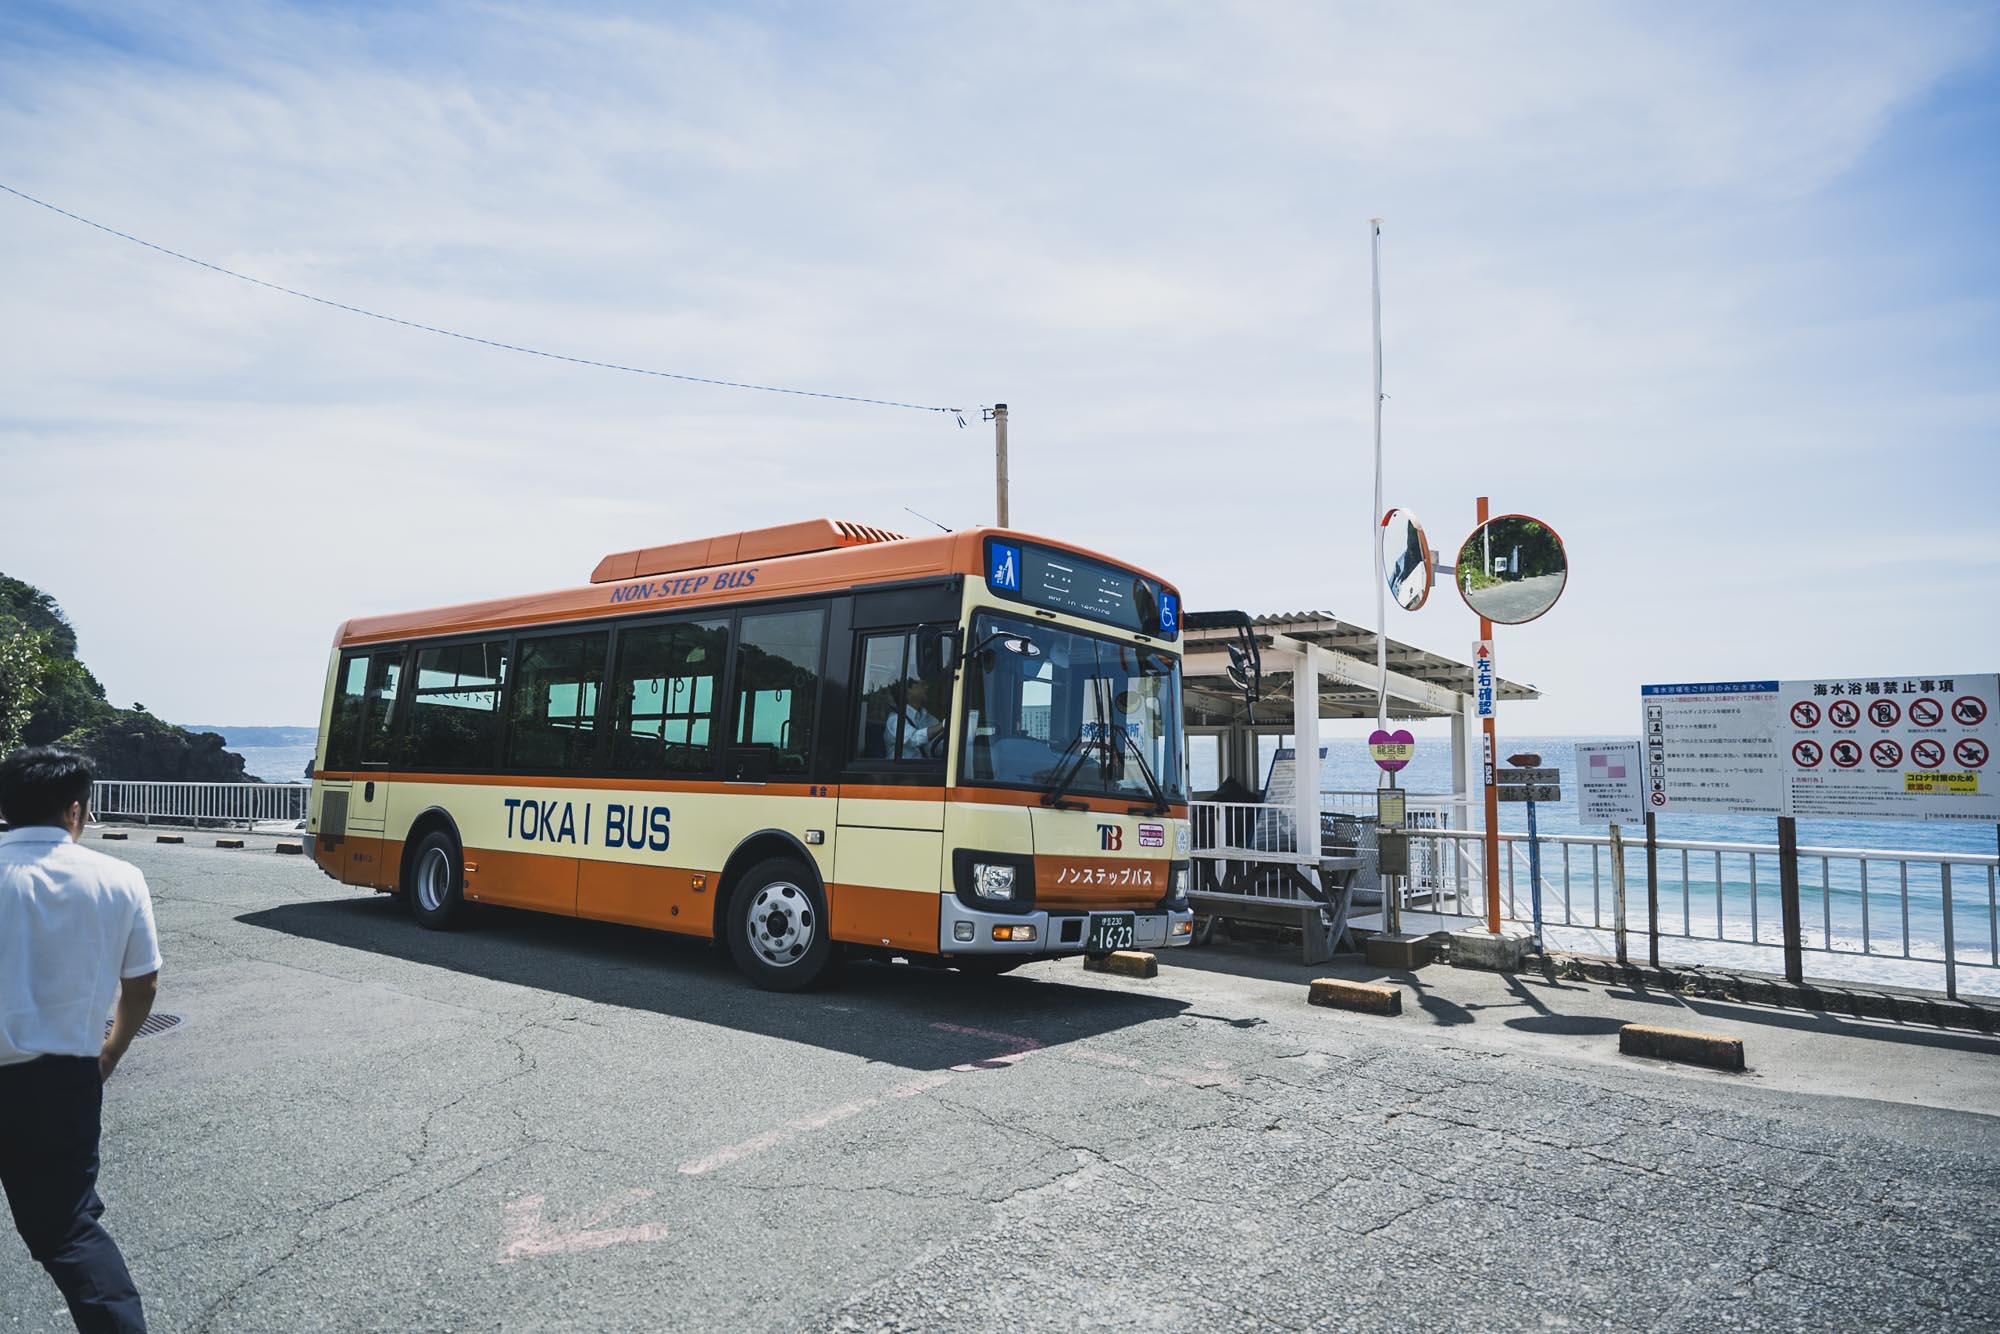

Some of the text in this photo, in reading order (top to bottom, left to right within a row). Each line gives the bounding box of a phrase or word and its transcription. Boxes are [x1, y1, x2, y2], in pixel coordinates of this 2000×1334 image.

[610, 568, 759, 603] NON-STEP BUS
[1477, 659, 1492, 715] 左右確認
[1813, 679, 1955, 696] 海水浴場禁止事項
[1907, 774, 1974, 782] コロナ対策のため
[504, 798, 671, 852] TOKAI BUS
[1097, 824, 1123, 851] TB
[1057, 867, 1152, 885] ノンステップバス
